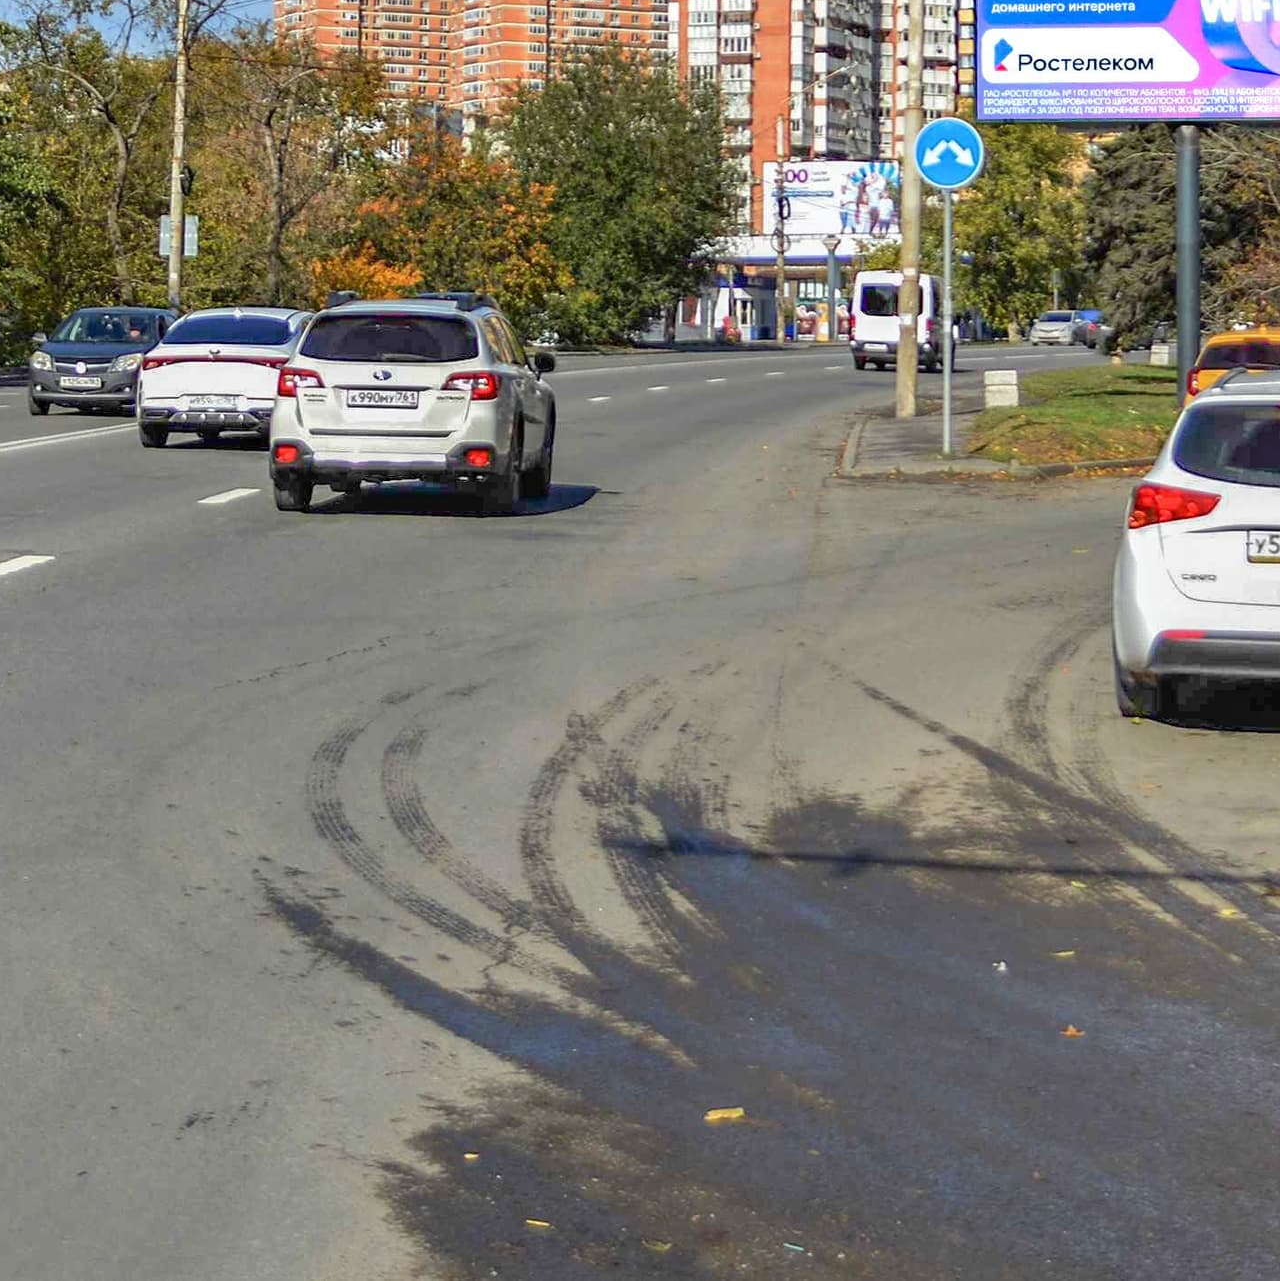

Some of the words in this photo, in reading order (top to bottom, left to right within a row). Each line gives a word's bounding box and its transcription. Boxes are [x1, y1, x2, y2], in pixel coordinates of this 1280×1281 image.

[991, 3, 1066, 14] домашнего
[1068, 2, 1136, 13] интернета
[1018, 54, 1154, 72] Ростелеком
